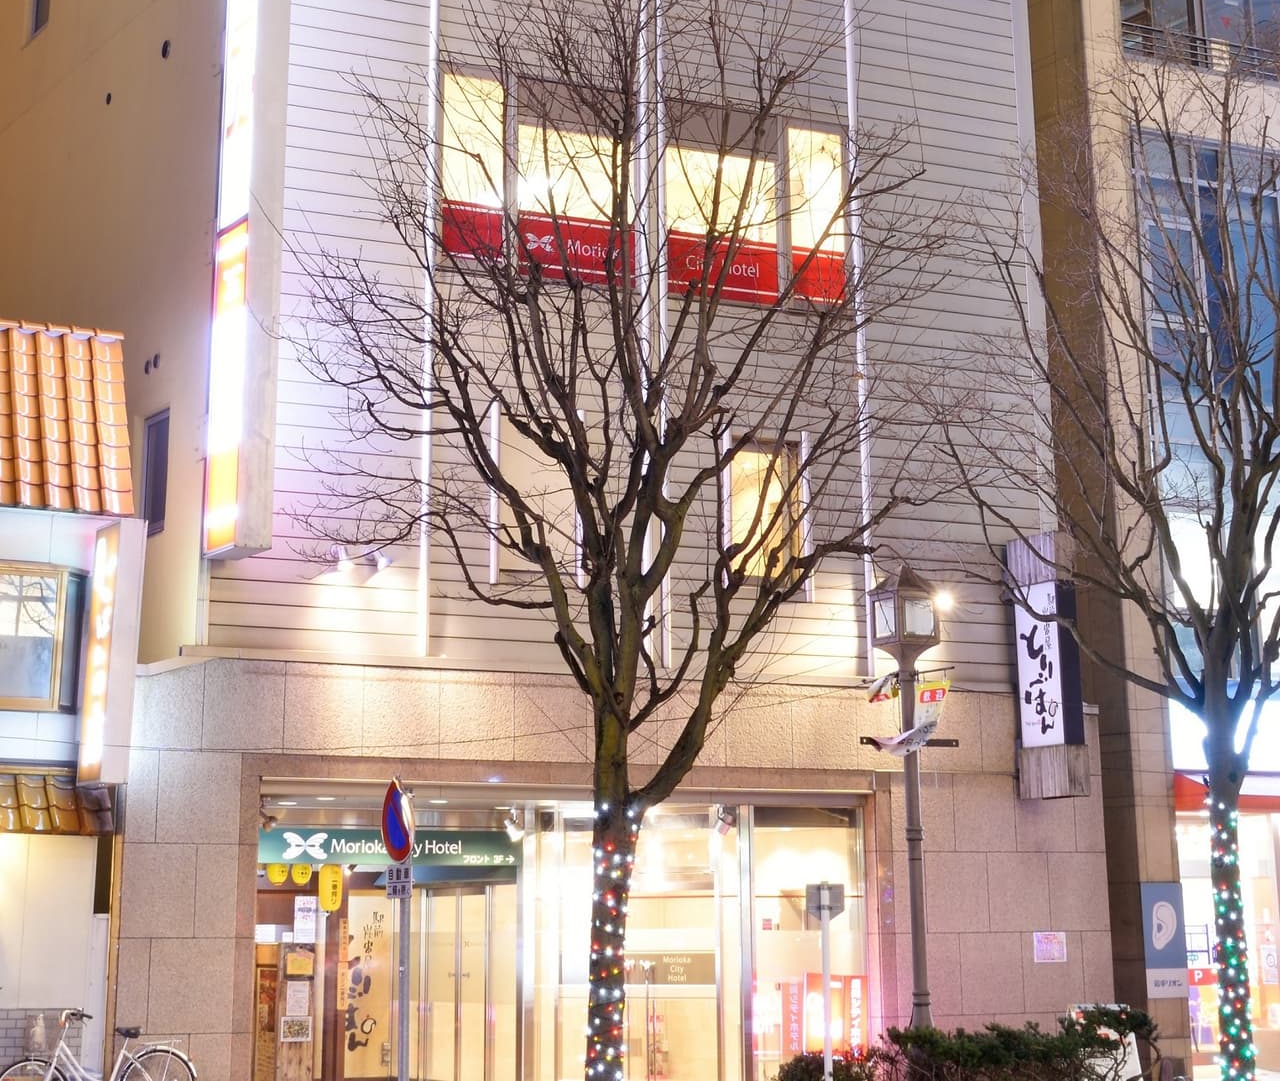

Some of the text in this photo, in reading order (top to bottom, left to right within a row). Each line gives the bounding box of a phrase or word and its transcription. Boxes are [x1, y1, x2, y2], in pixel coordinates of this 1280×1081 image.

[567, 239, 621, 260] Moriok
[686, 255, 713, 273] Ciy
[330, 838, 387, 854] Morioka
[425, 839, 462, 855] Hotel
[463, 854, 491, 865] フロント
[662, 955, 692, 964] Morioka
[669, 965, 684, 974] City
[667, 974, 687, 982] Hotel
[1194, 970, 1203, 982] P
